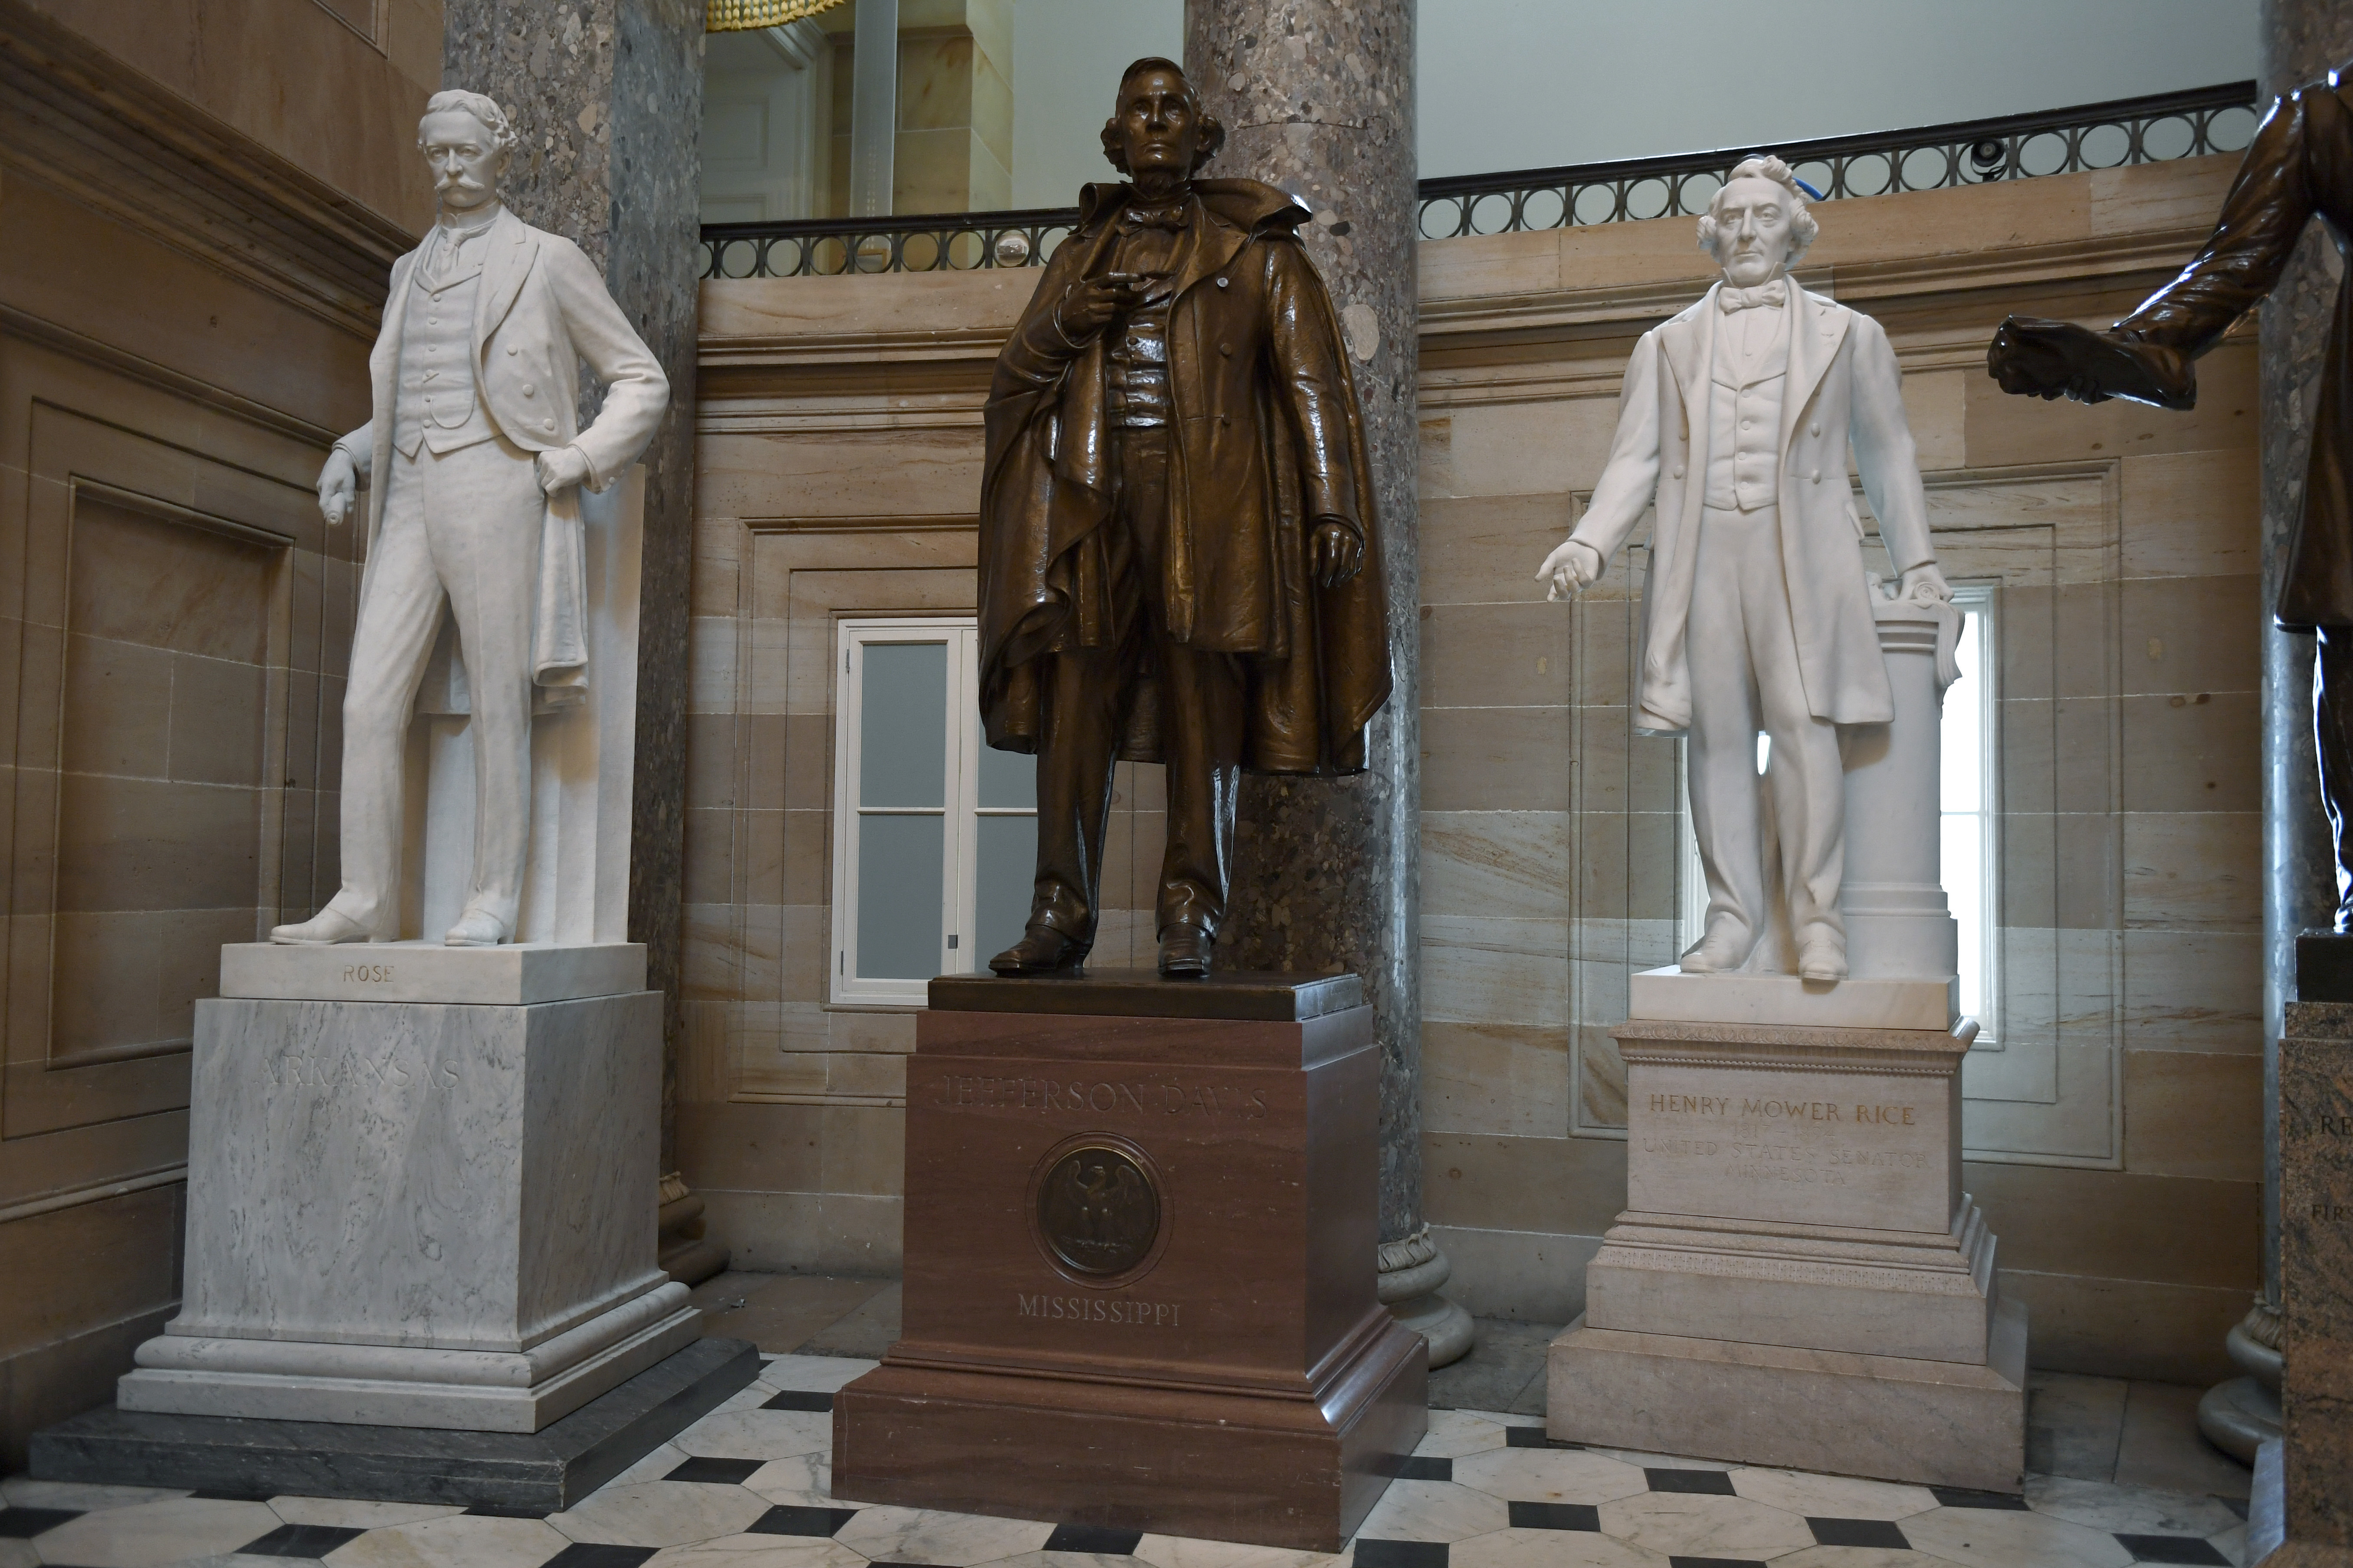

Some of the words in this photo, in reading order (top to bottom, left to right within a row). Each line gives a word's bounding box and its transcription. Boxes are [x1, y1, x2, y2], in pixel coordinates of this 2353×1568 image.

[344, 965, 394, 983] ROSE
[253, 1055, 460, 1089] ARKANSAS
[934, 1074, 1144, 1115] JEFFERSON
[1161, 1084, 1268, 1119] DAVIS
[1649, 1094, 1729, 1116] HENRY
[1741, 1099, 1840, 1121] MOWER
[1855, 1104, 1915, 1125] RICE
[1643, 1138, 1718, 1156] UNITED
[1731, 1142, 1816, 1163] STATES
[1829, 1148, 1930, 1169] SENATOR
[1725, 1163, 1847, 1186] MINNESOTA
[1018, 1293, 1180, 1326] MISSISSIPPI
